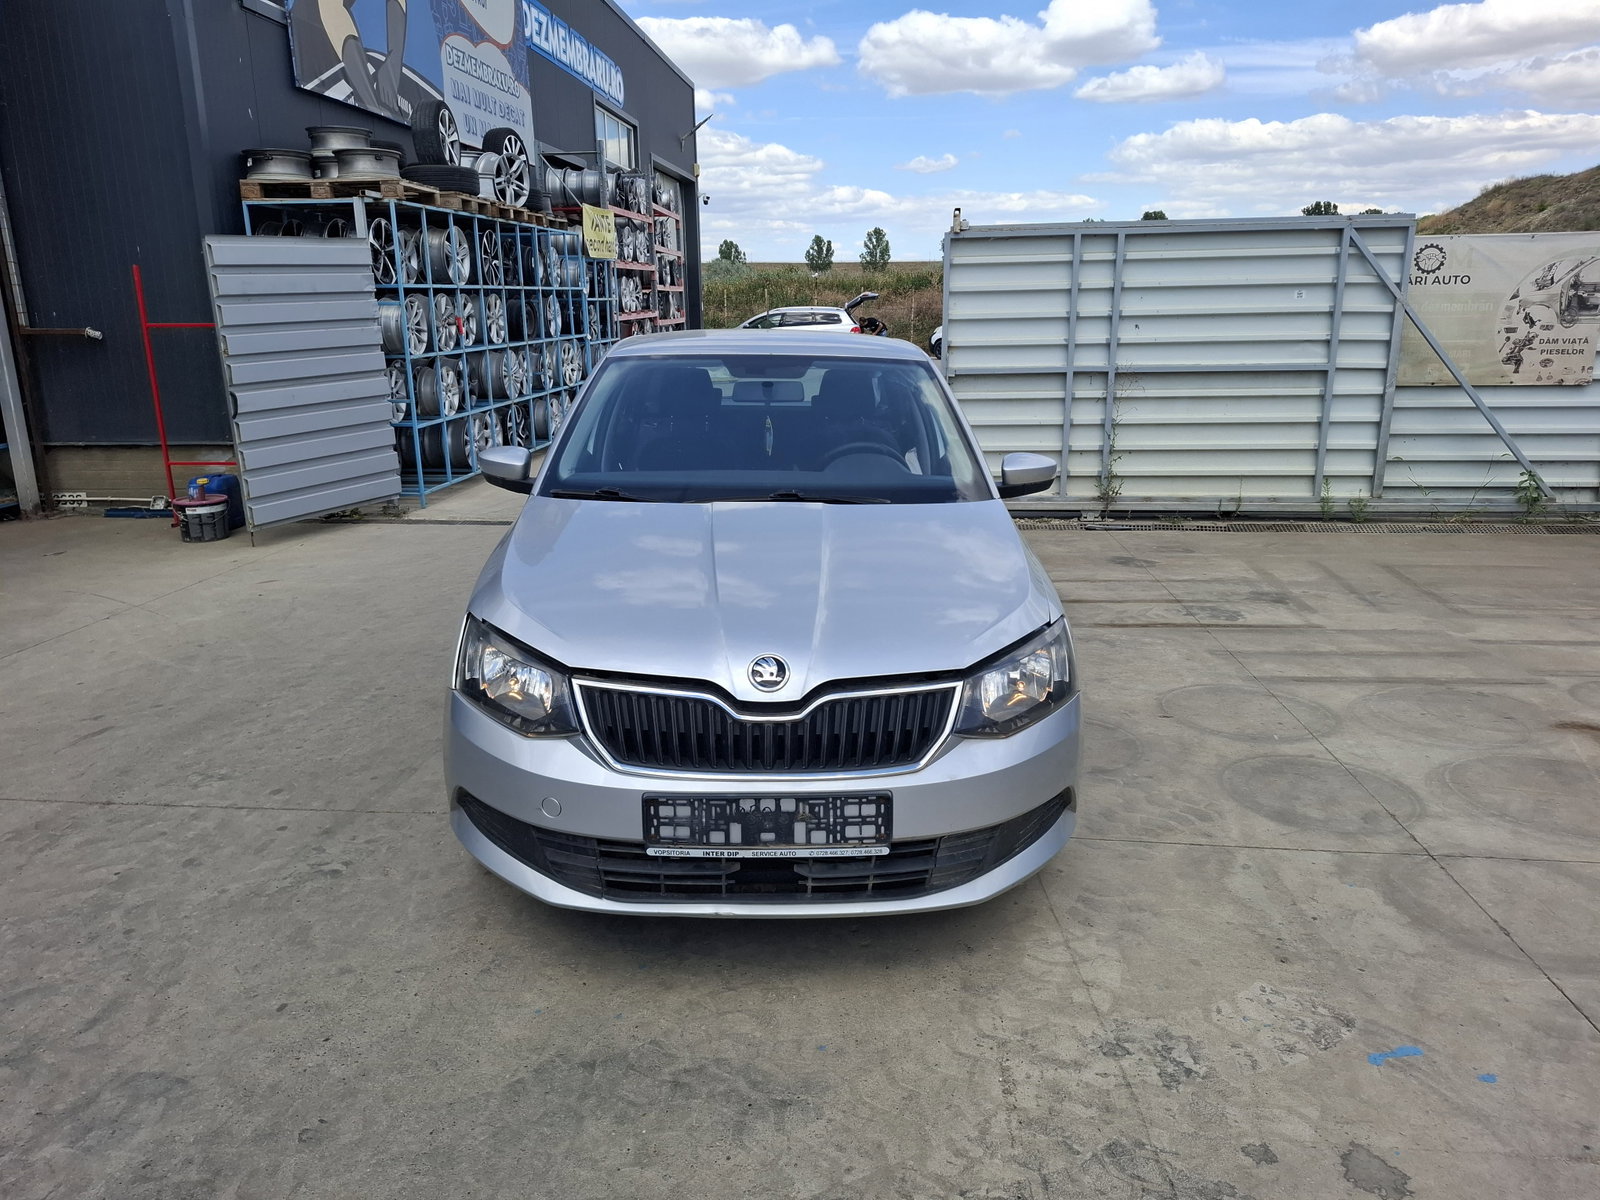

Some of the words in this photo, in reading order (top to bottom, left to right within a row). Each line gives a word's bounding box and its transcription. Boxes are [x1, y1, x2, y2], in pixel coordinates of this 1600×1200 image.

[450, 78, 471, 104] MAI
[472, 88, 497, 116] MULT
[463, 113, 478, 136] UN
[1431, 275, 1471, 285] AUTO
[1540, 348, 1585, 356] PIESELOR
